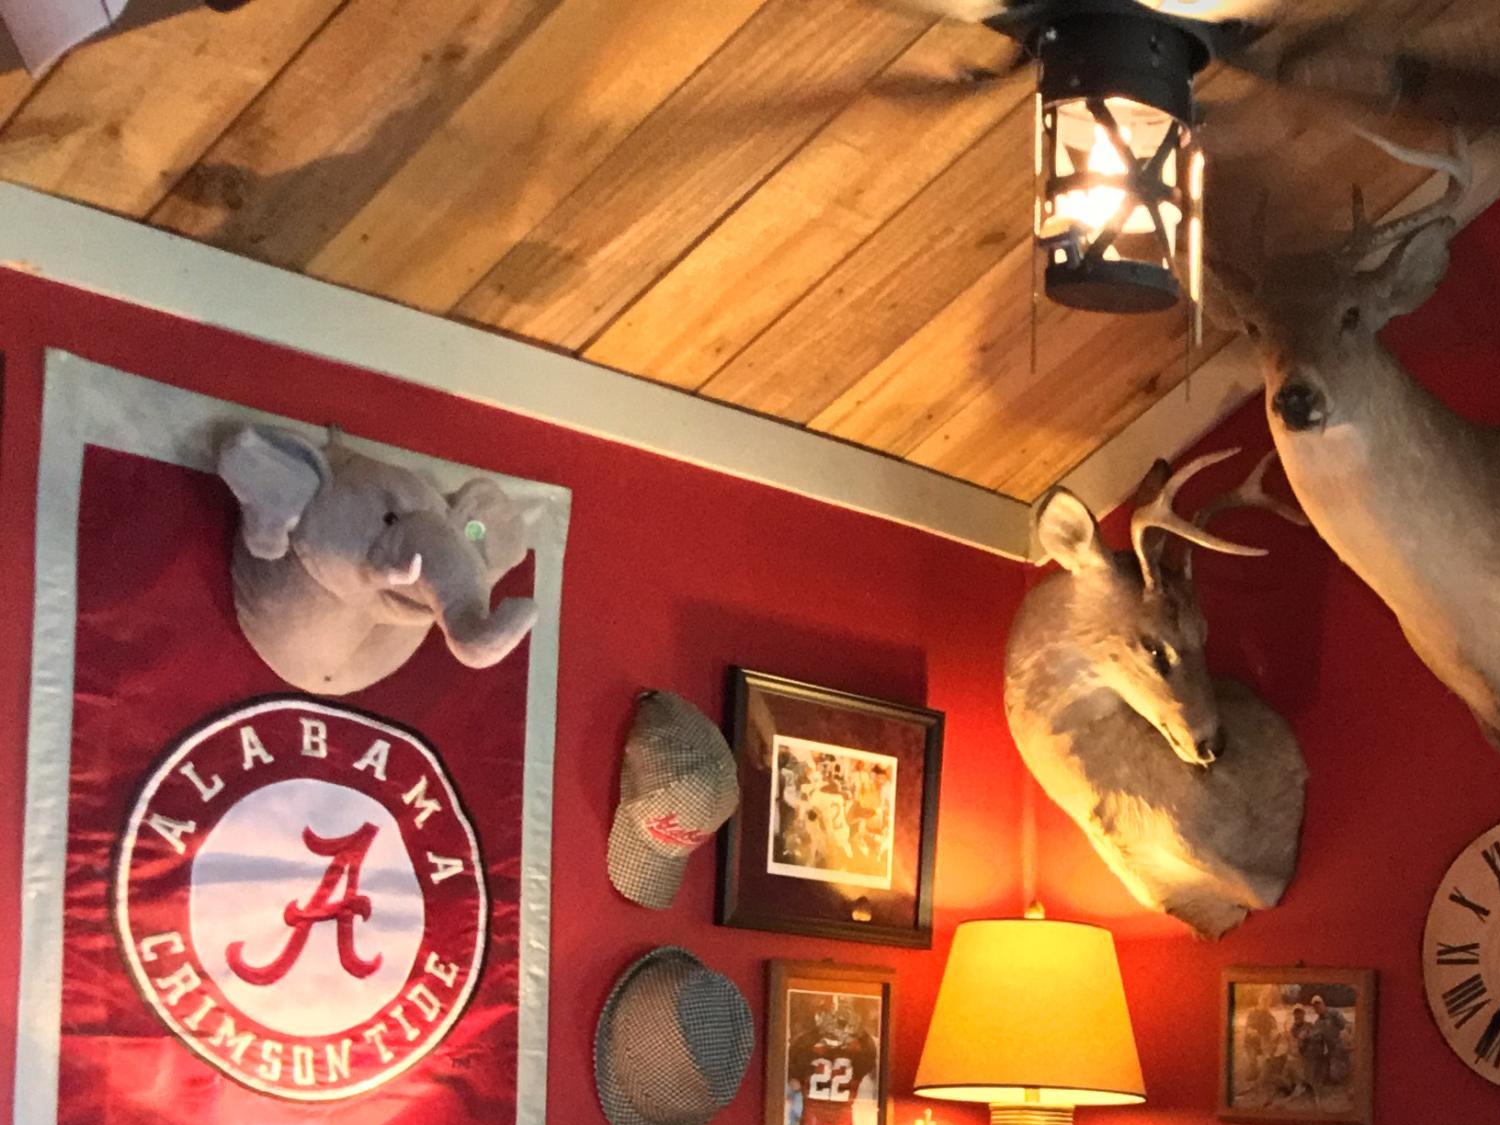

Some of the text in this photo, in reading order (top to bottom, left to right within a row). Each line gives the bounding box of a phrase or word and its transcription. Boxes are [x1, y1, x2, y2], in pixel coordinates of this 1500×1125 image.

[145, 718, 464, 884] ALABAMA
[140, 931, 459, 1085] CRIMSON TIDE
[808, 1057, 853, 1102] 22
